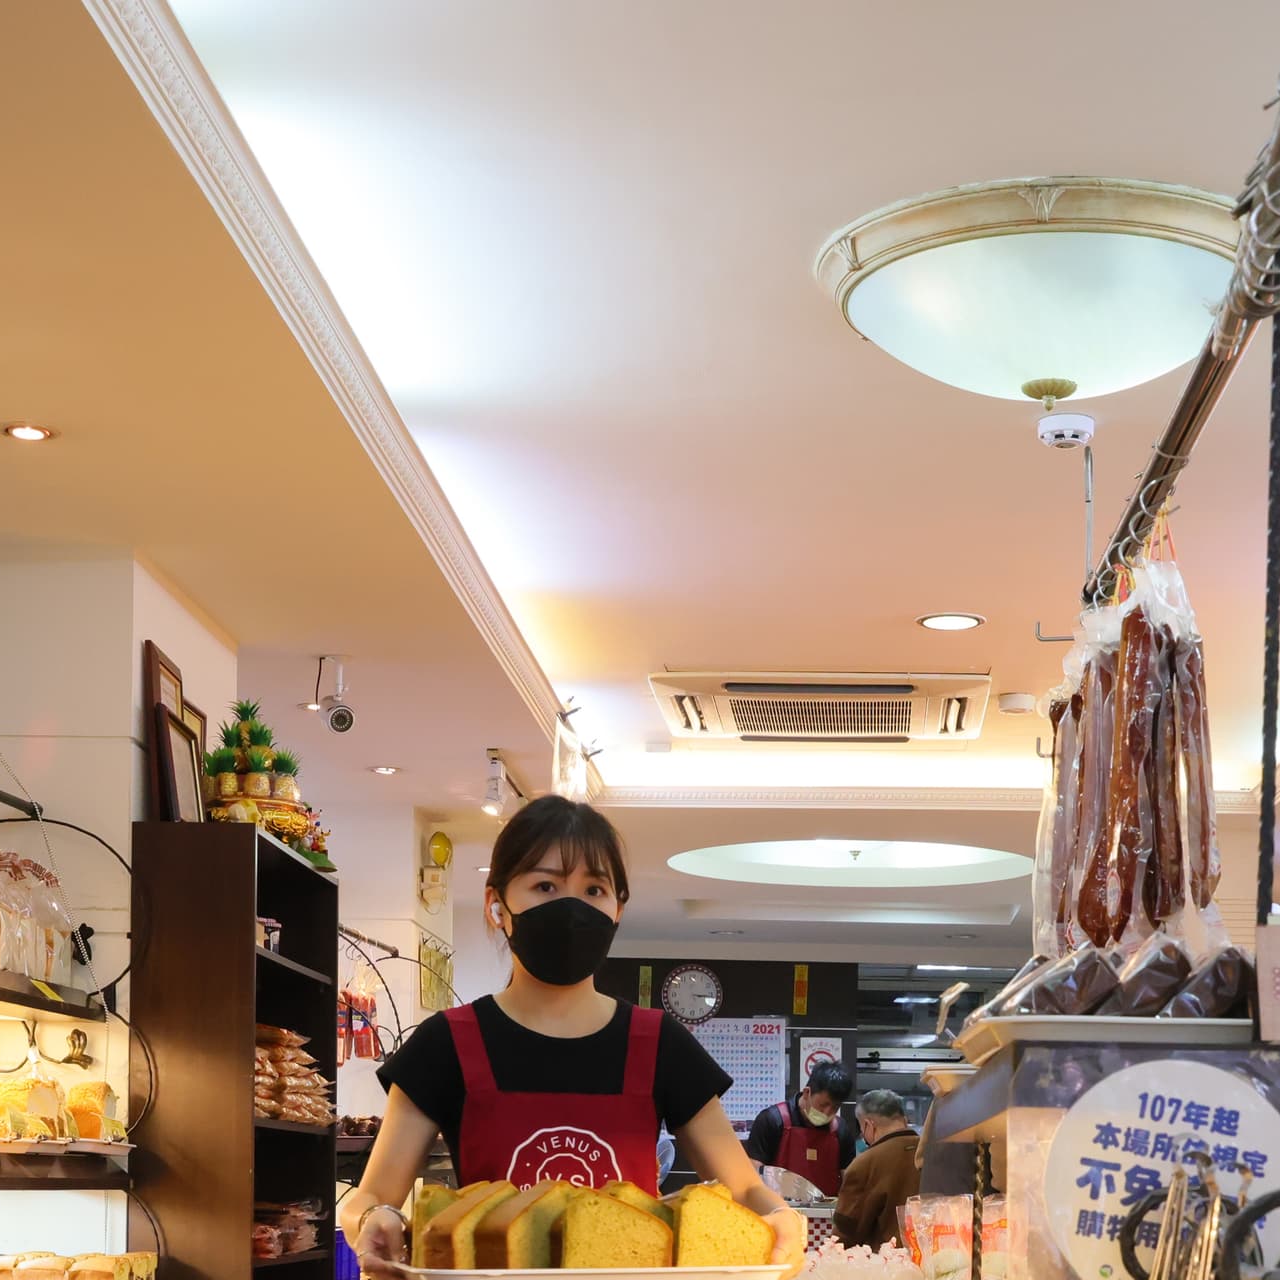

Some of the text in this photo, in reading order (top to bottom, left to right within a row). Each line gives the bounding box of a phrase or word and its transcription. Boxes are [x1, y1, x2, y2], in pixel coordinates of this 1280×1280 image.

[752, 1024, 781, 1035] 2021
[1138, 1092, 1241, 1137] 107年起
[536, 1136, 601, 1162] VENUS
